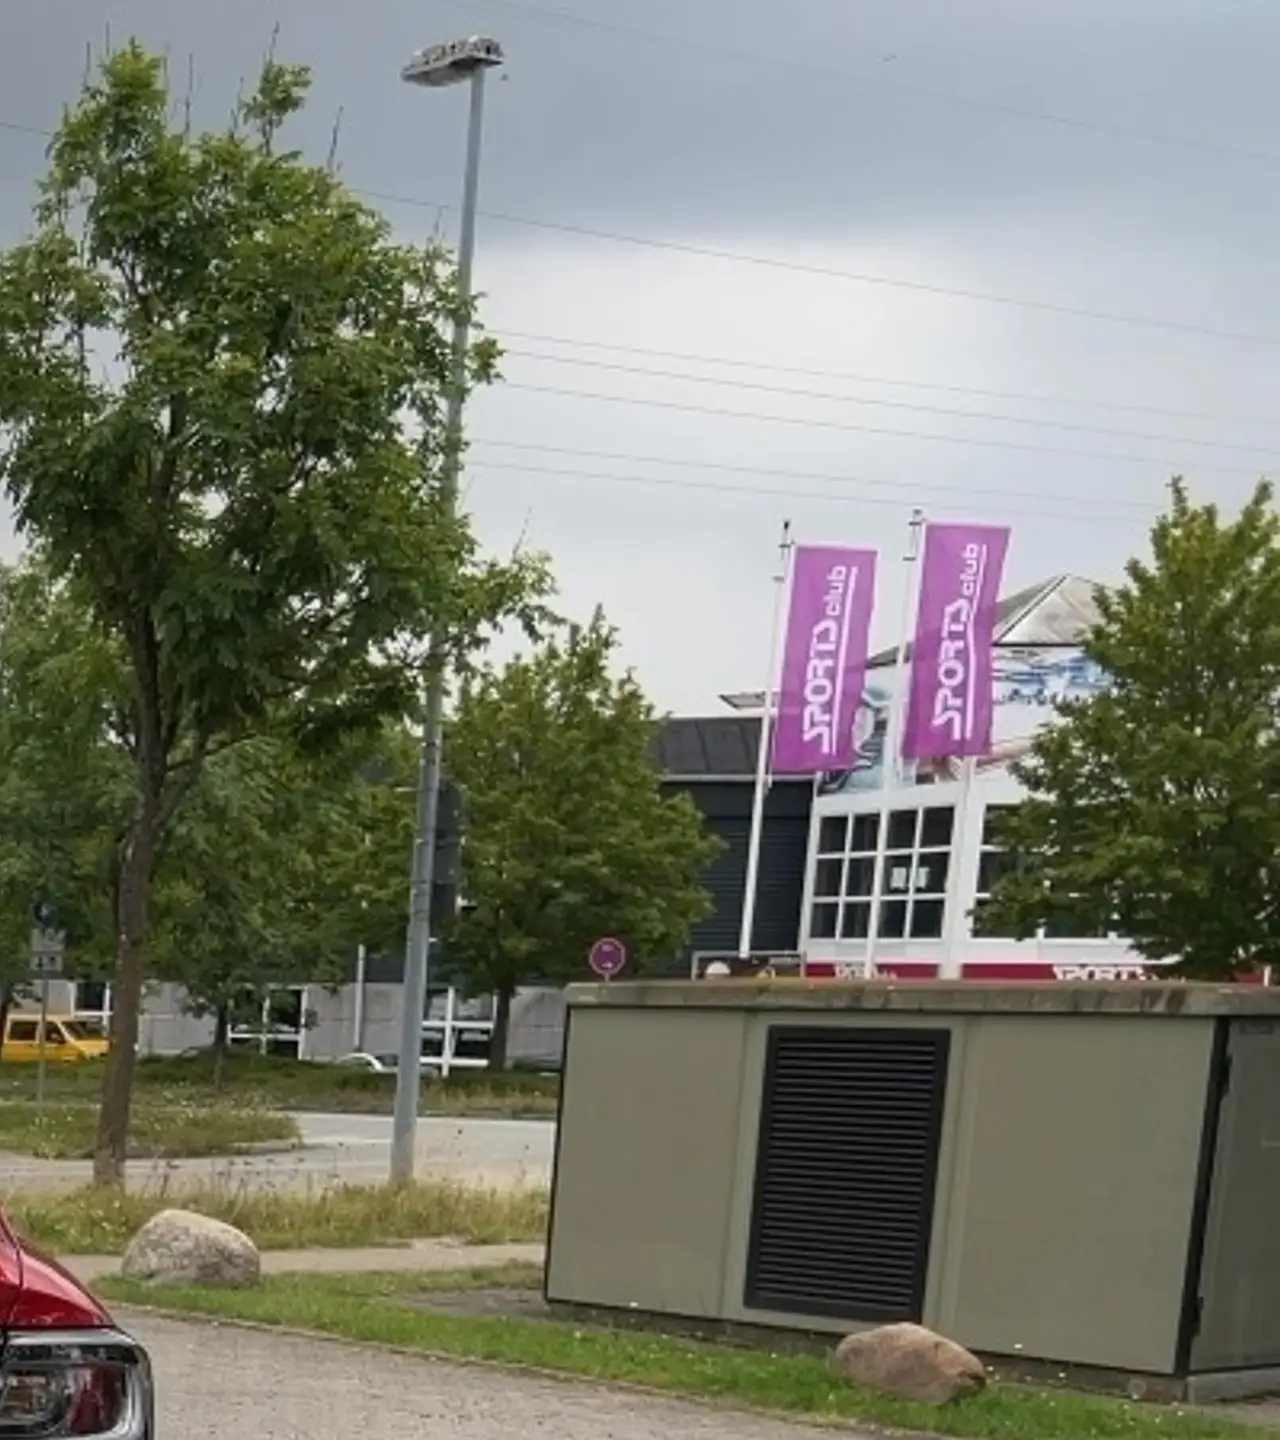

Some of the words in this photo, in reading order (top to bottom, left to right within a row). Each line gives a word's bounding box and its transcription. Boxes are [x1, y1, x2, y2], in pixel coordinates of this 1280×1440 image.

[803, 617, 839, 754] SPORTS
[823, 564, 847, 617] club
[930, 597, 970, 741] SPORTS
[960, 542, 980, 597] club
